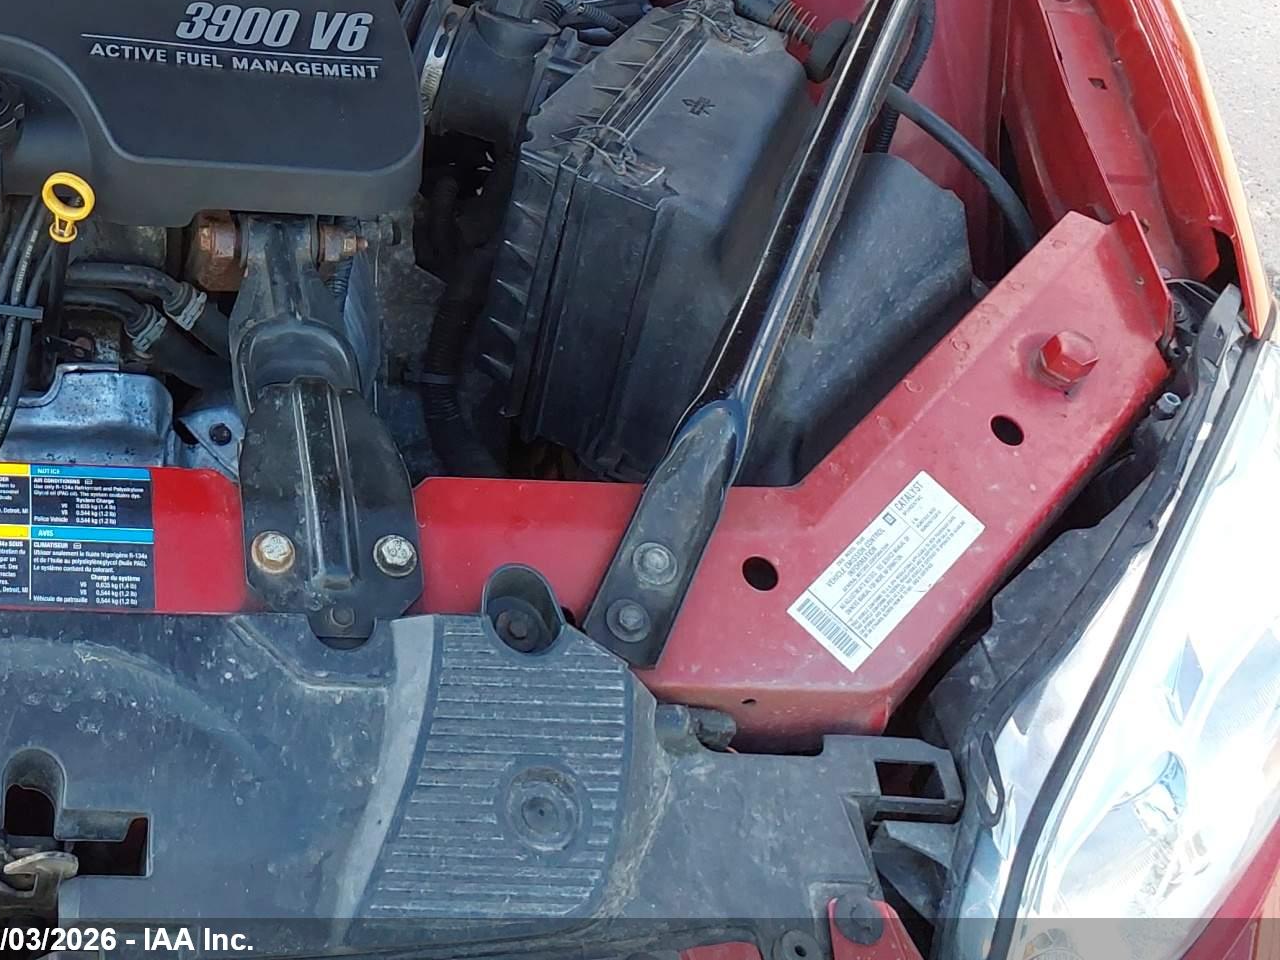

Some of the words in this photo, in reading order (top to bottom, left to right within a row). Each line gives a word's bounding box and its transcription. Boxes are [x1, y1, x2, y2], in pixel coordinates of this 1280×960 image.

[176, 2, 300, 48] 3900
[310, 11, 374, 52] V6
[89, 43, 167, 63] ACTIVE
[176, 51, 223, 68] FUEL
[232, 56, 379, 79] MANAGEMENT
[894, 480, 924, 511] CATALYST
[38, 529, 54, 537] AVIS
